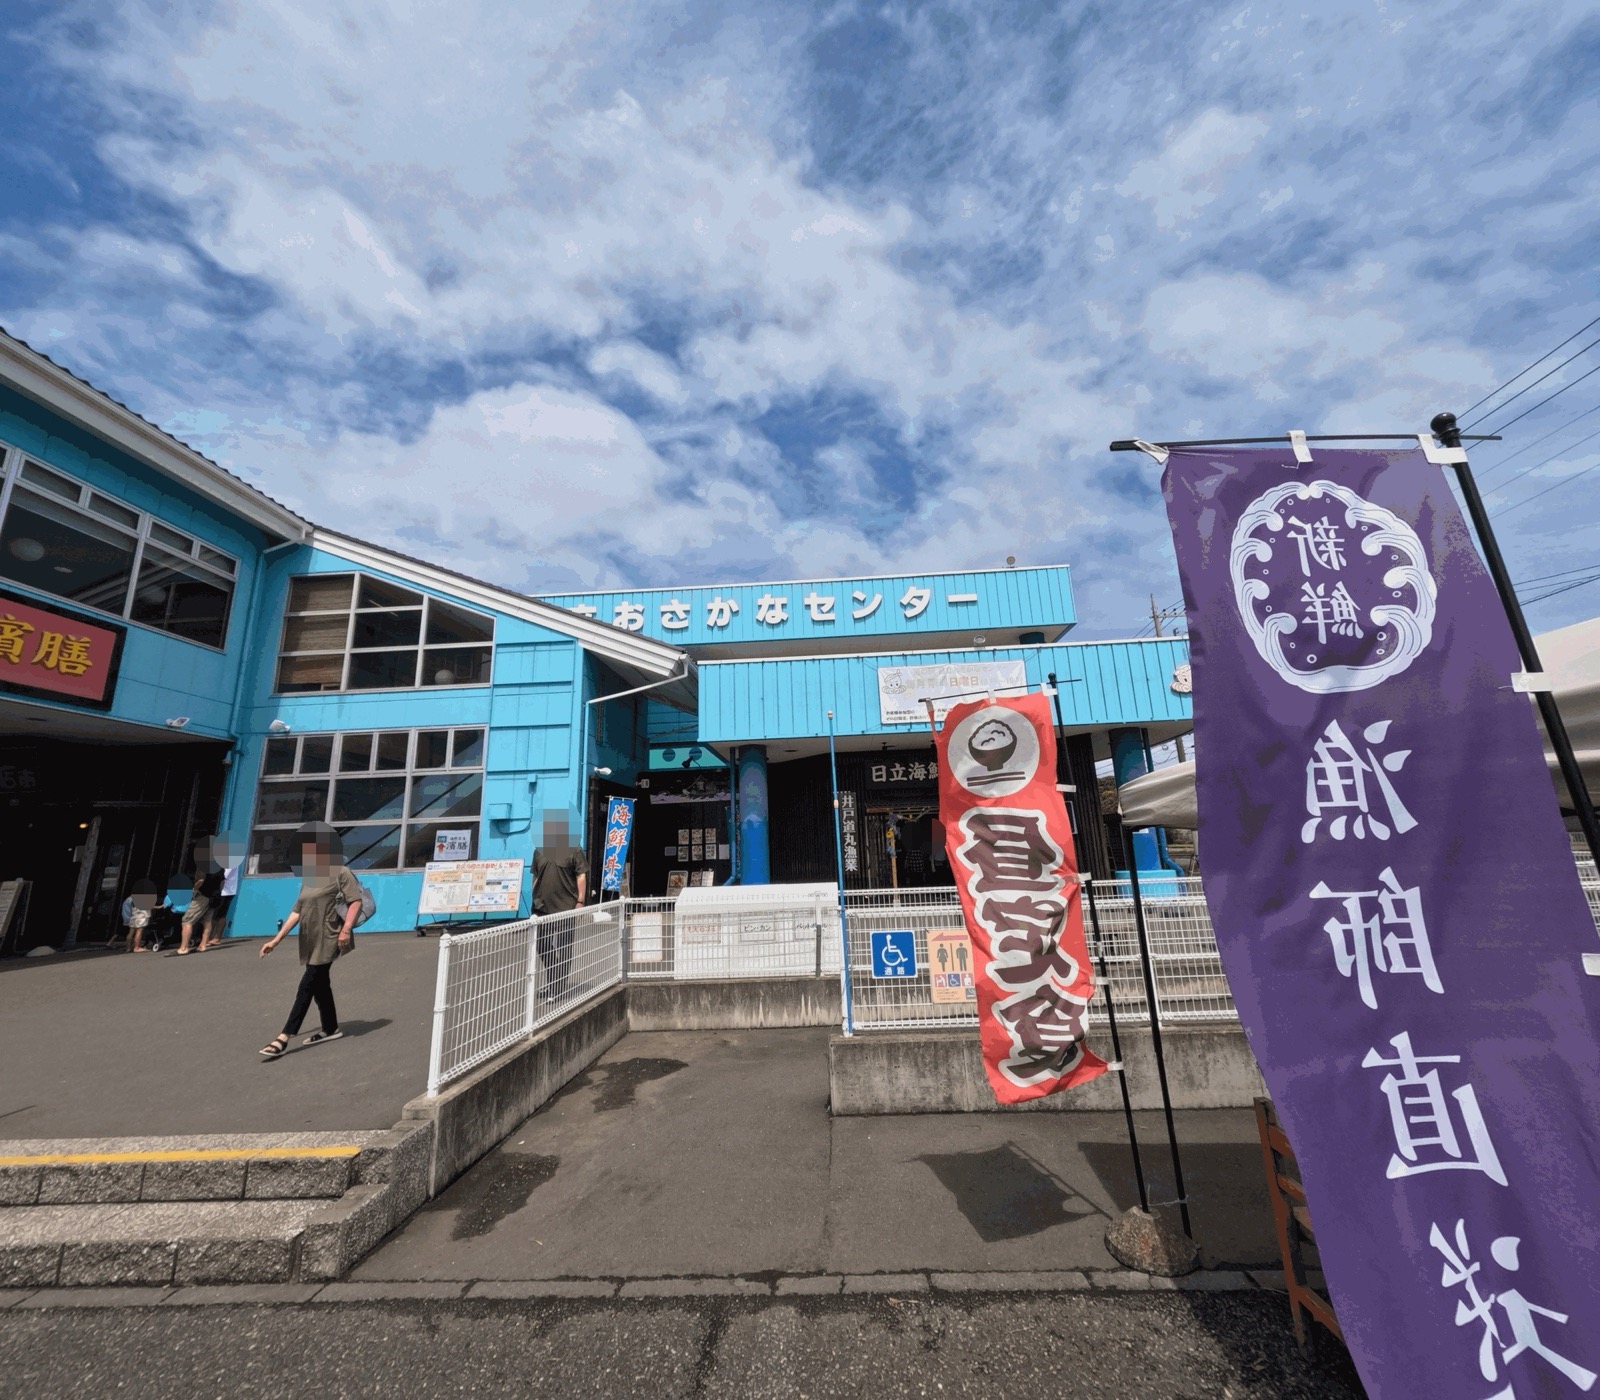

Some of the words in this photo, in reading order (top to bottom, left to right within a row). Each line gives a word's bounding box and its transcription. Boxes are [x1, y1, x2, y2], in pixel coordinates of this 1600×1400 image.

[841, 795, 858, 872] 井戸道丸漁業
[796, 922, 828, 930] ペットボル
